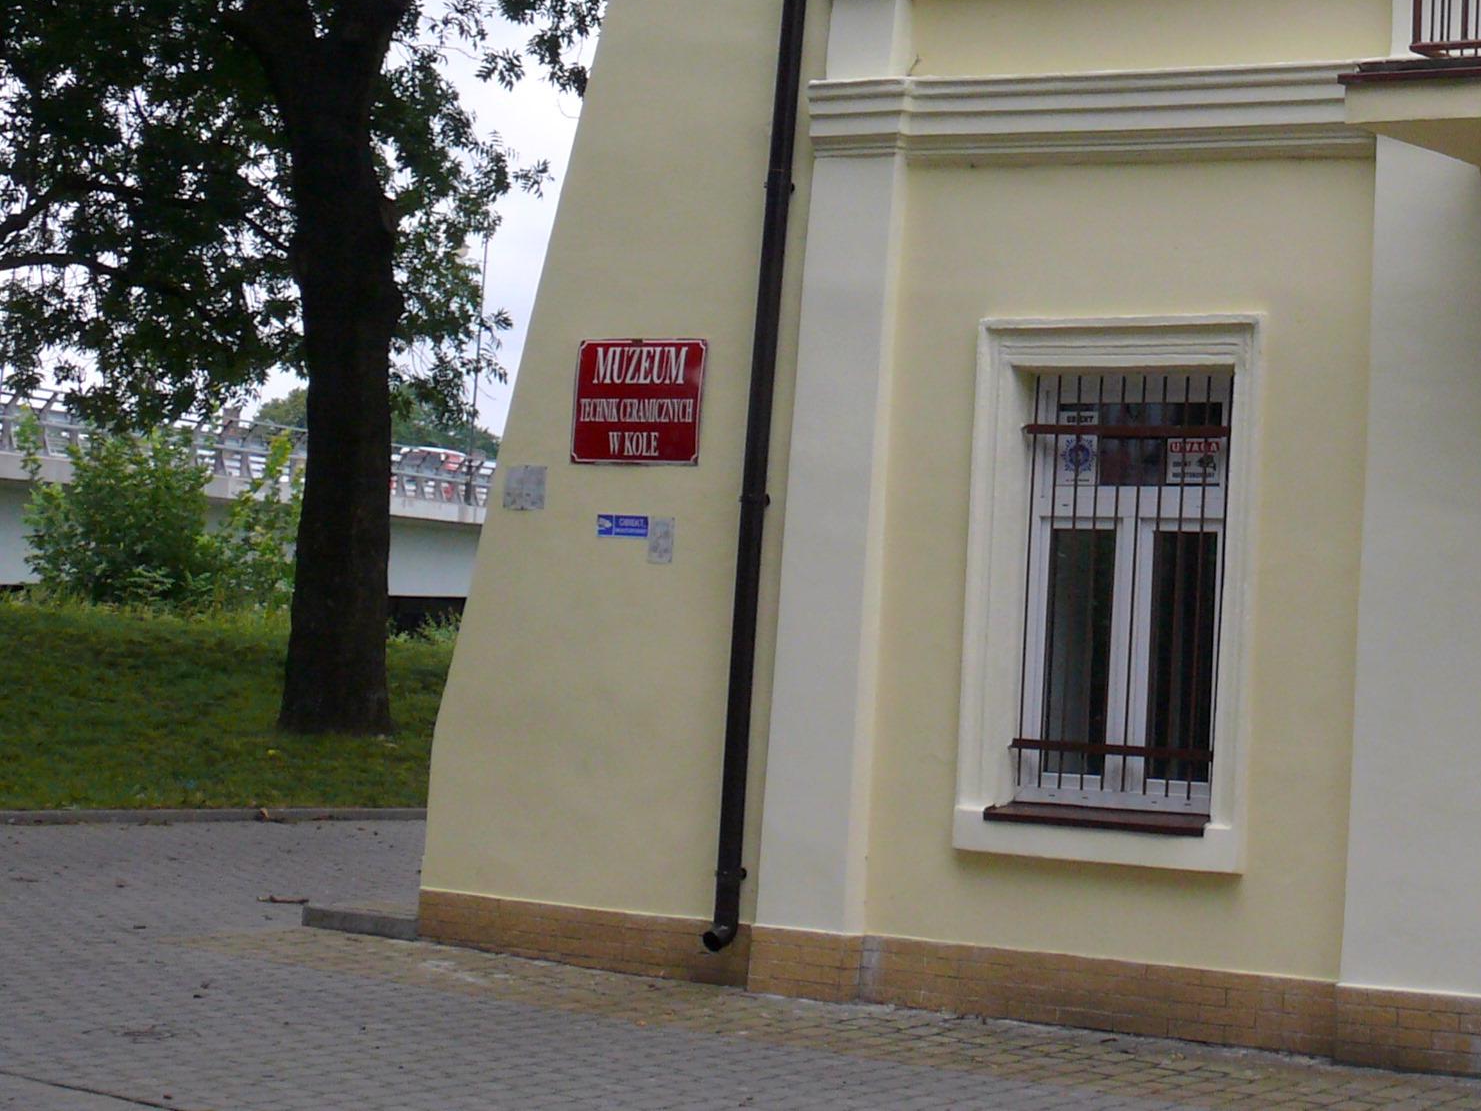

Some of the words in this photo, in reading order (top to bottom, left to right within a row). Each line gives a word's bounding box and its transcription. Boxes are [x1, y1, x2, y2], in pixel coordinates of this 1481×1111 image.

[593, 347, 688, 384] MUZEUM
[580, 398, 619, 422] TECHNIK
[620, 399, 693, 423] CERAMICZNYCH
[609, 432, 622, 455] W
[624, 432, 659, 456] KOLE
